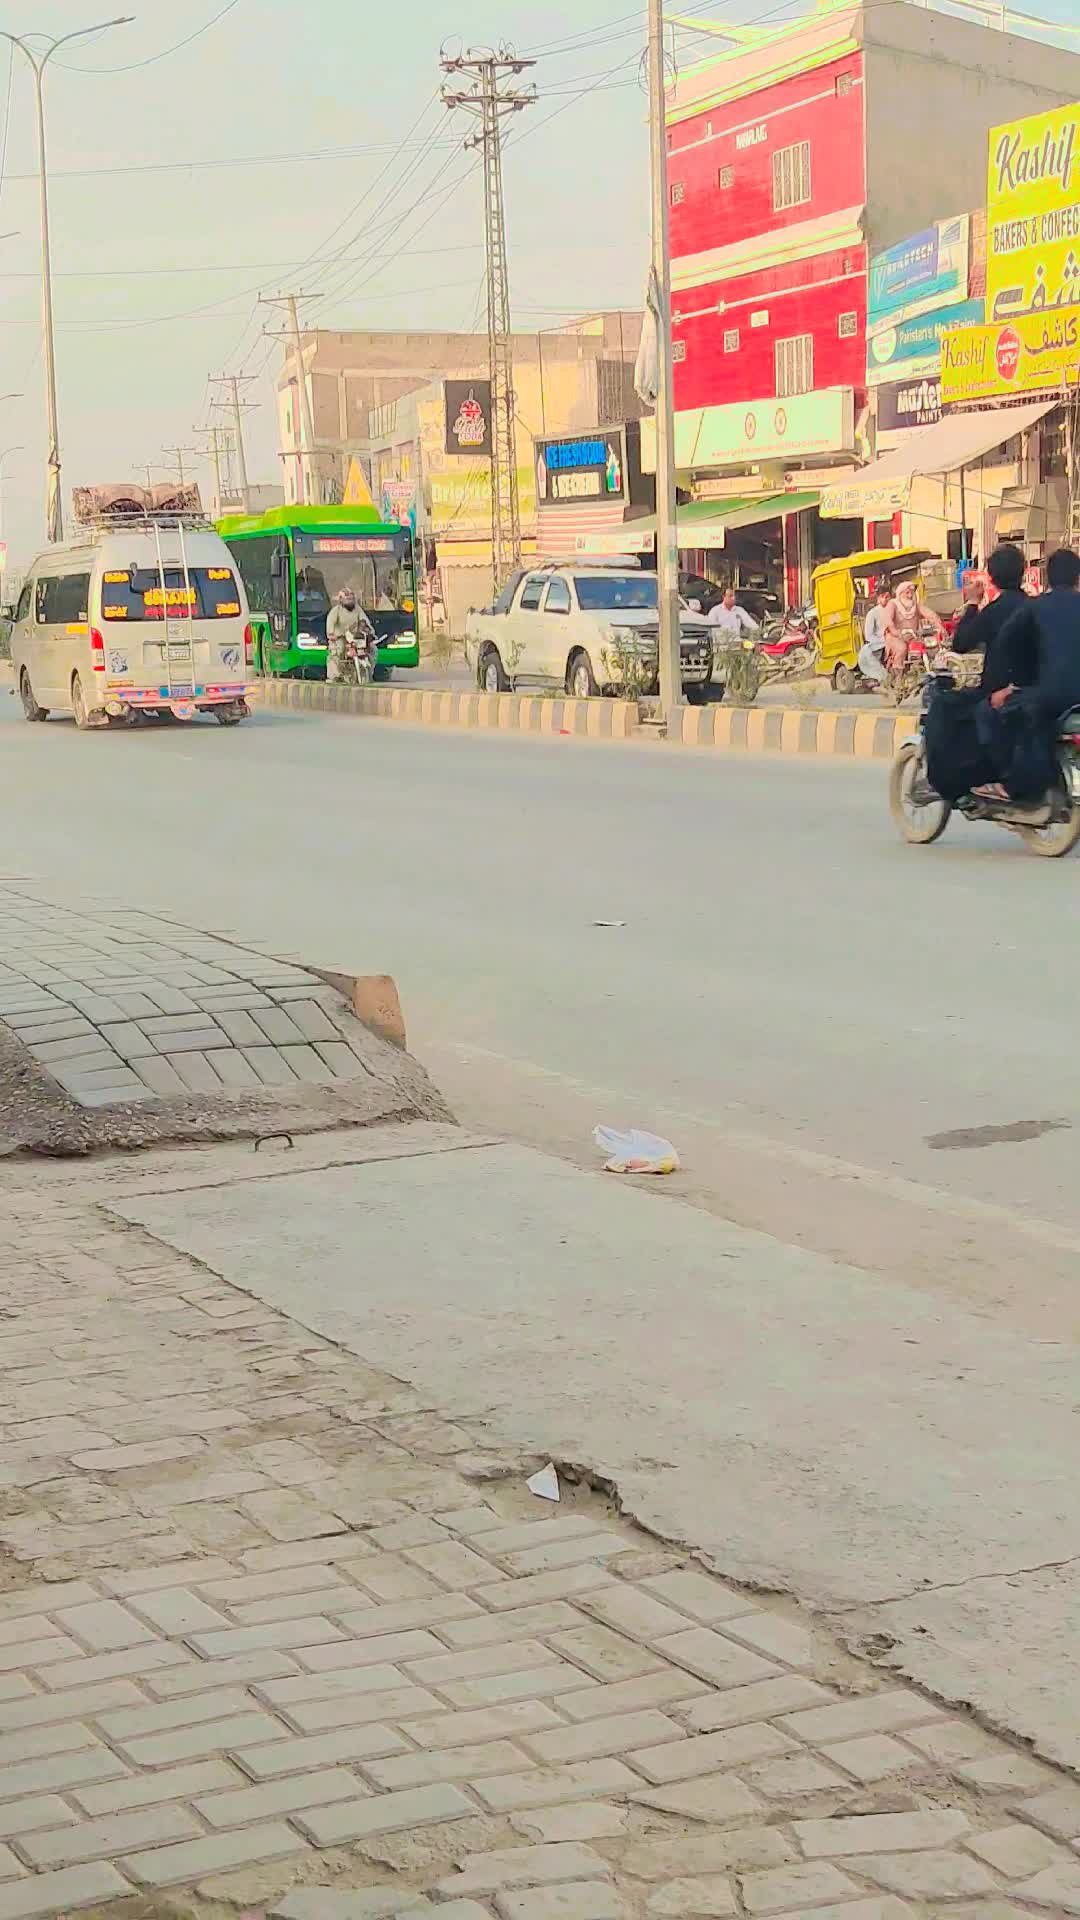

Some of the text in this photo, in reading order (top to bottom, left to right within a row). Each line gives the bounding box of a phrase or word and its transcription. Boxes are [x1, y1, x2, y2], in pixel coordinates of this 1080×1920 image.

[996, 122, 1076, 192] Kashif
[993, 221, 1028, 253] BAKERS
[1031, 216, 1037, 244] &
[942, 335, 989, 374] Kashif
[916, 408, 943, 424] PAINTS
